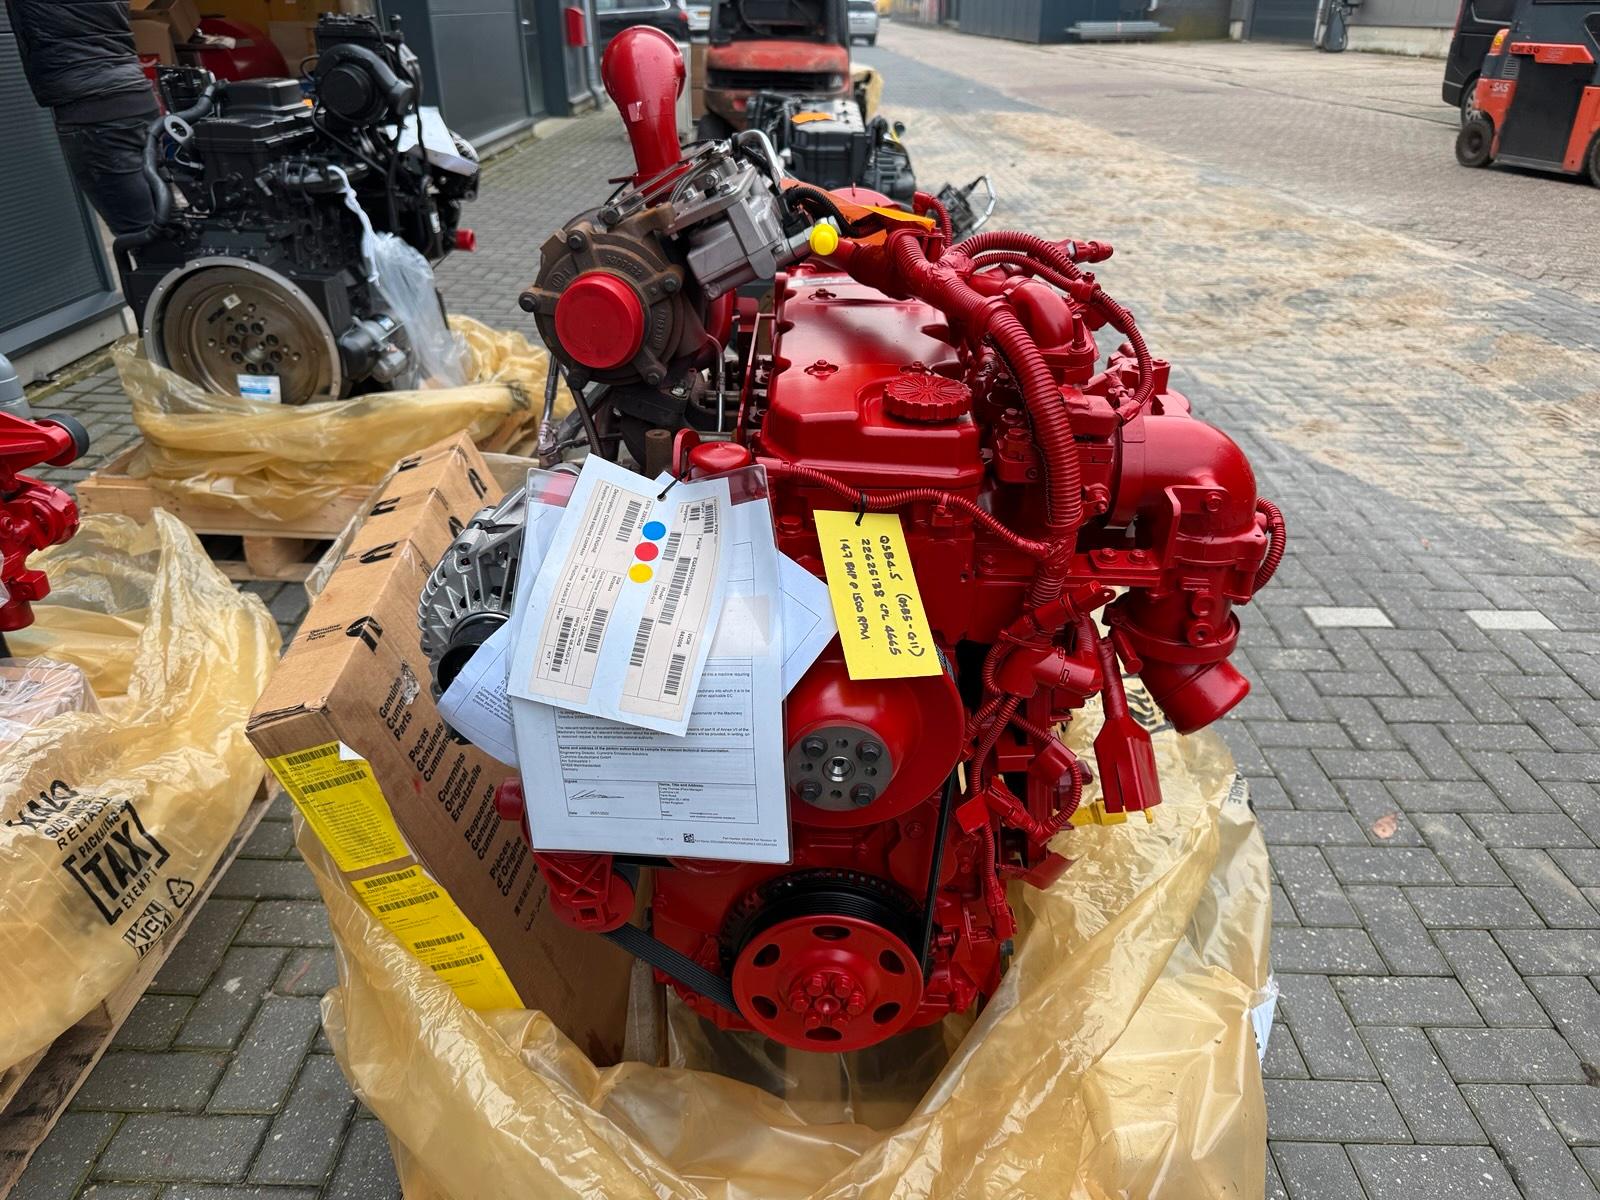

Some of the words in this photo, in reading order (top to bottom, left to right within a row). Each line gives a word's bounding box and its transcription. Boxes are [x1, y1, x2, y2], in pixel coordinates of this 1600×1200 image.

[378, 675, 402, 719] Genuine
[393, 709, 412, 741] Parts
[408, 726, 430, 763] Peças
[415, 721, 443, 772] Genuínas
[423, 730, 451, 782] Cummins
[437, 751, 465, 803] Cummins
[443, 766, 470, 813] Original
[450, 763, 481, 822] Ersatzteile
[463, 782, 495, 842] Repuestos
[476, 813, 502, 860] Cummin
[488, 838, 512, 879] Pièces
[80, 820, 152, 901] TAX
[500, 843, 529, 897] Cummins
[121, 866, 158, 910] EXEMPT
[138, 911, 165, 941] VCI
